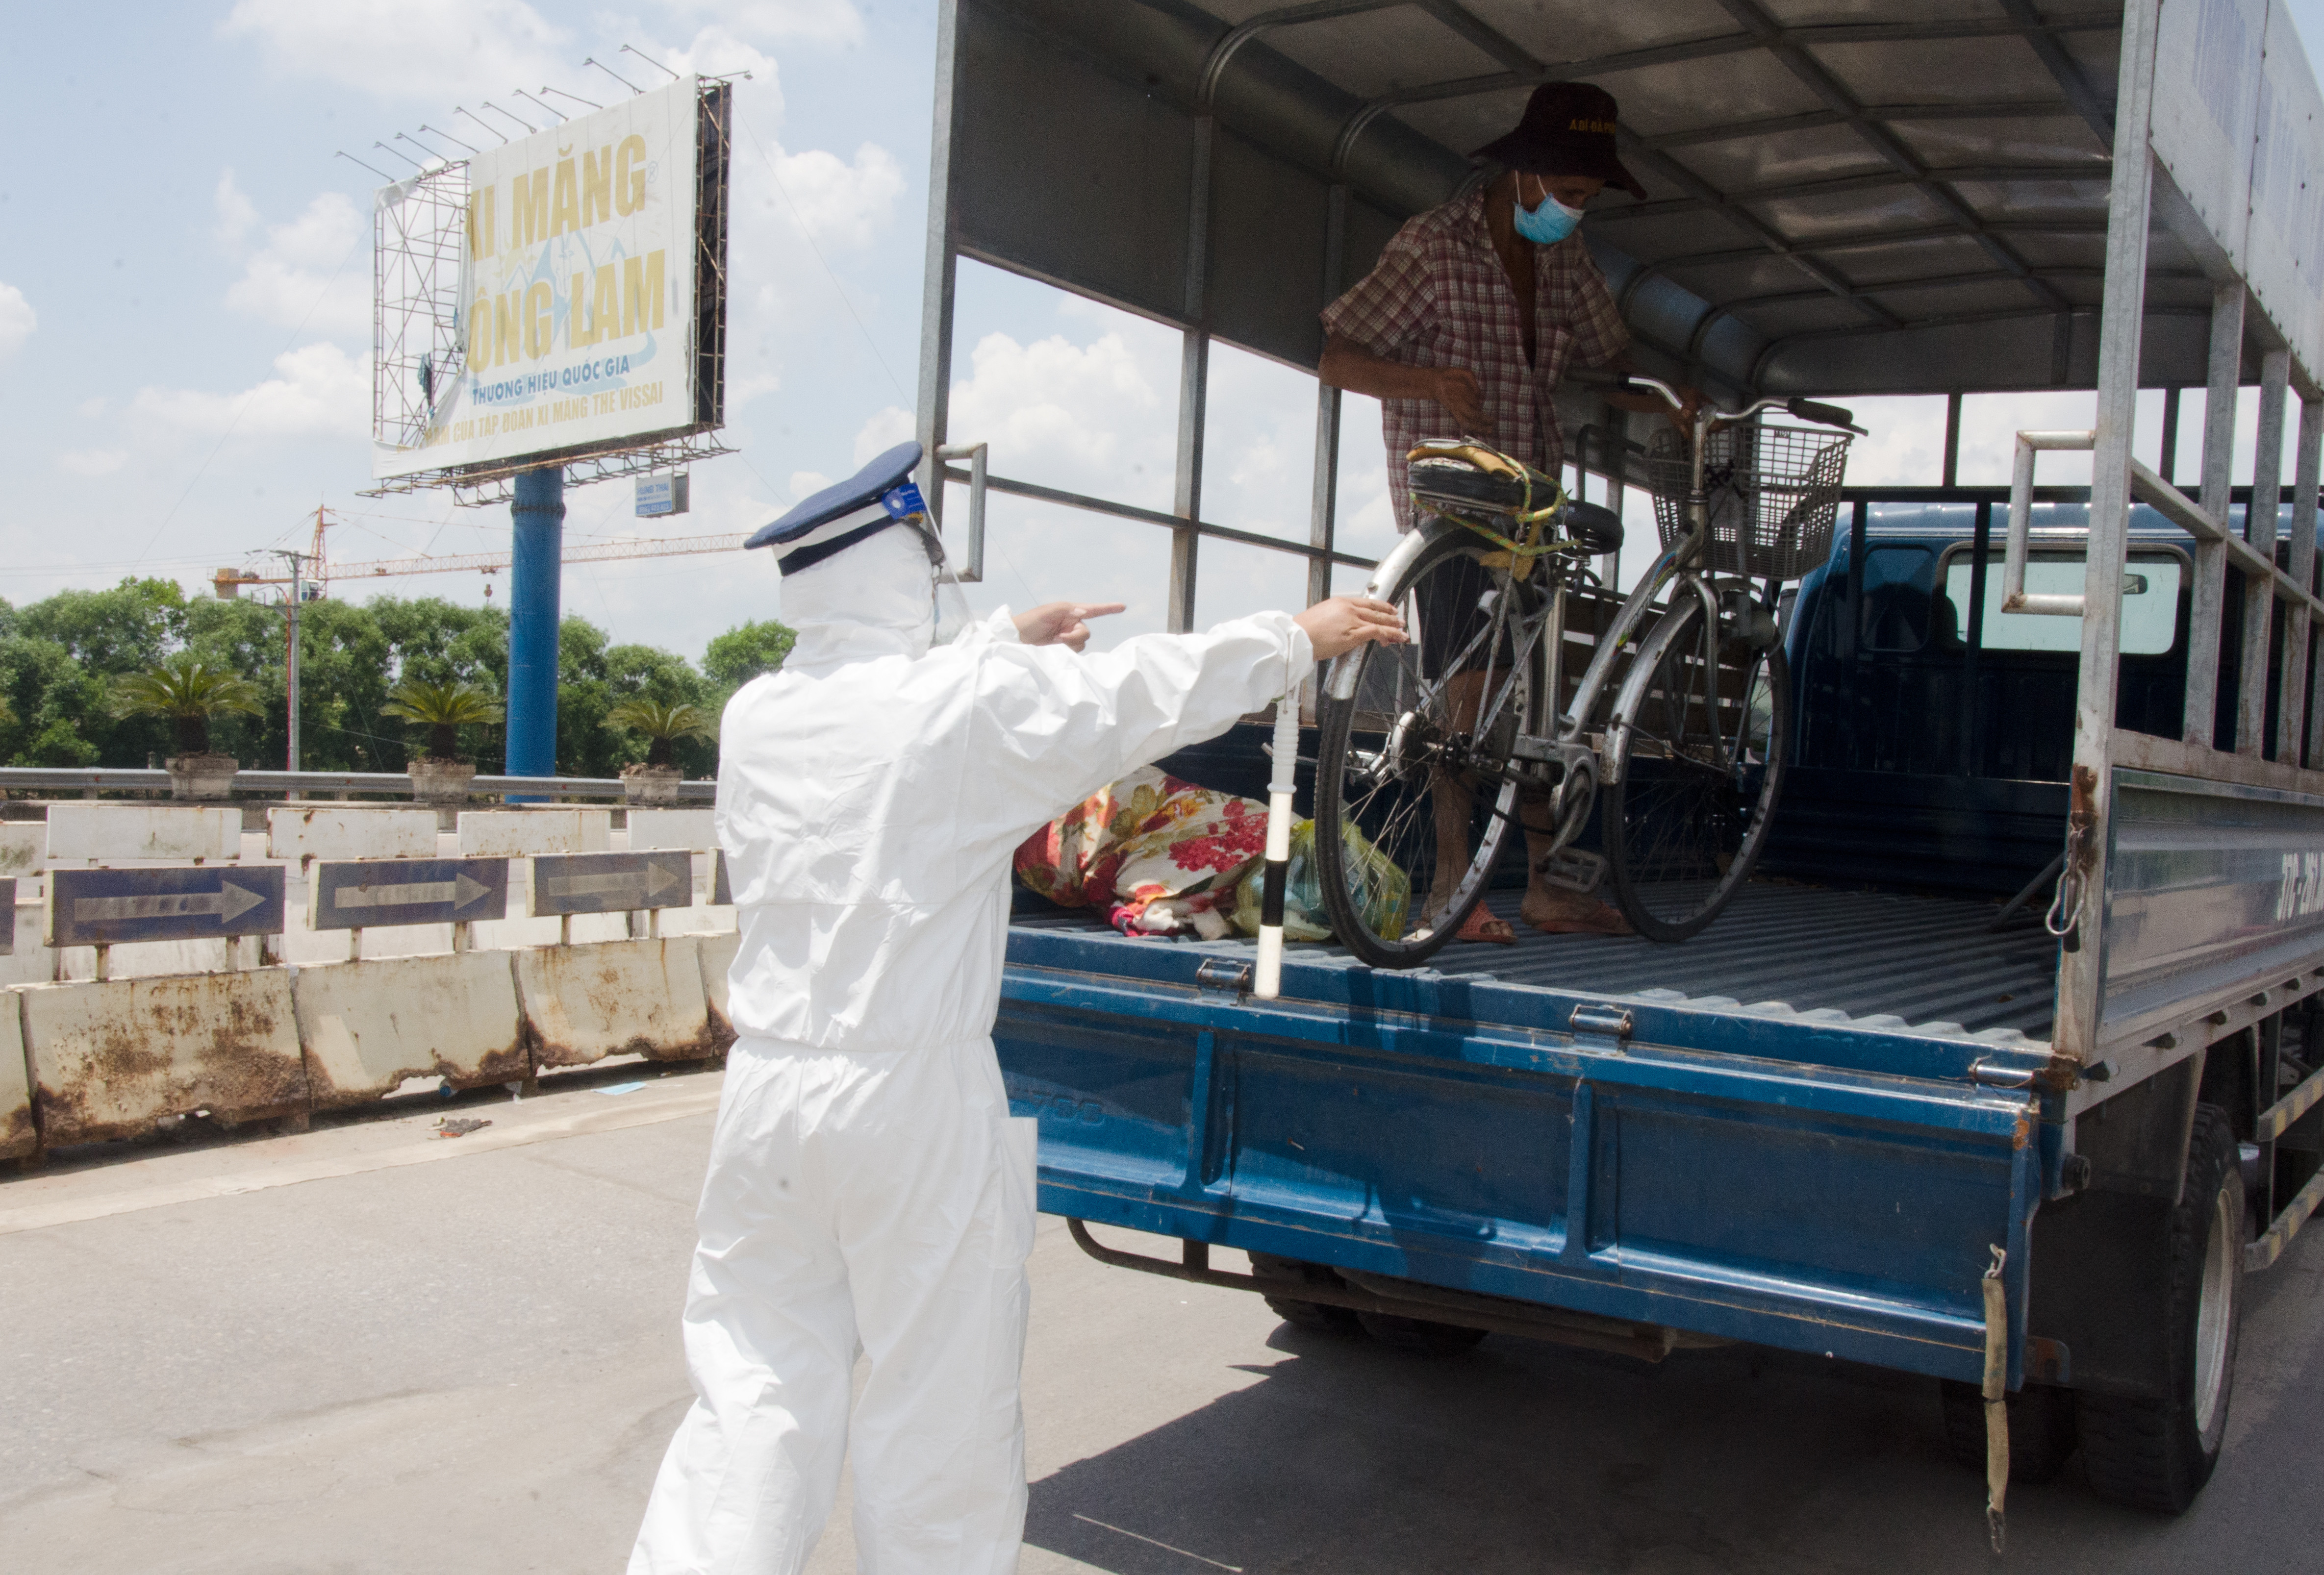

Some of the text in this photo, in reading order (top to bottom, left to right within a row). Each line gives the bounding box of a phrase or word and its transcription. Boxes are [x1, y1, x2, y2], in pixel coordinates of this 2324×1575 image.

[512, 134, 646, 250] MĂNG
[528, 369, 557, 395] HIỆU
[562, 356, 600, 386] QUỐC
[605, 355, 630, 377] GIA
[537, 404, 549, 426] XI
[553, 396, 588, 423] MĂNG
[593, 391, 615, 416] THE
[620, 381, 663, 411] VISSAI
